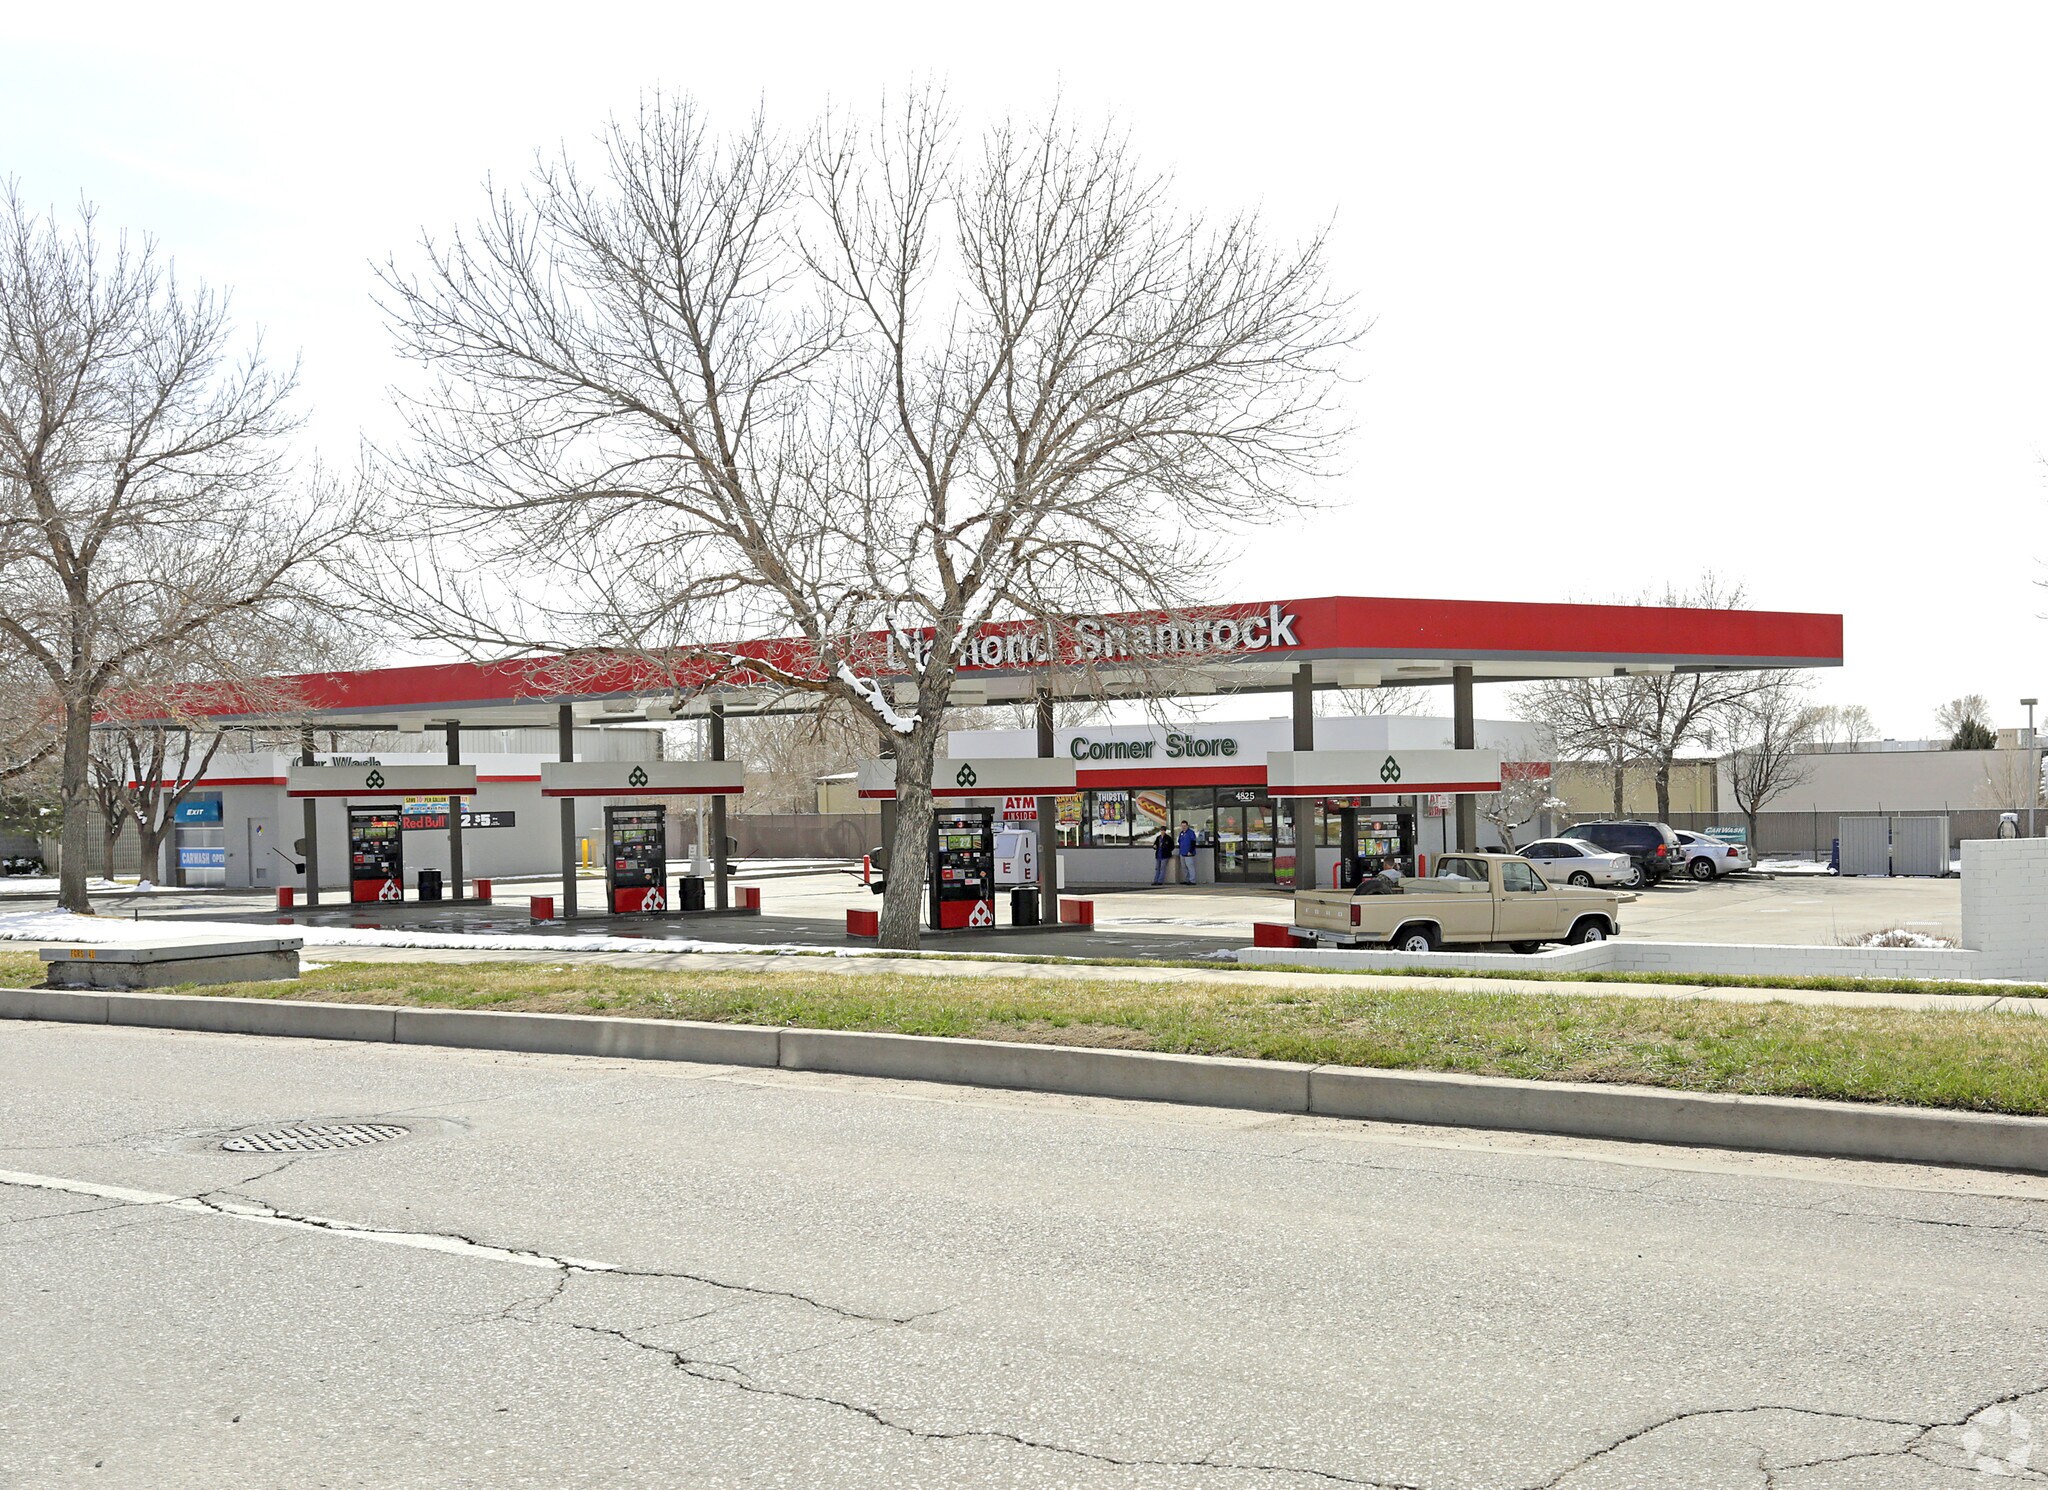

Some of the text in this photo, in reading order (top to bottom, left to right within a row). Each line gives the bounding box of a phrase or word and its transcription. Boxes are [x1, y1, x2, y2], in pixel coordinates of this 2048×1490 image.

[1074, 605, 1299, 660] Shamrock
[1070, 734, 1238, 760] Corner Store
[1098, 793, 1126, 802] THIRSTY
[1236, 792, 1255, 800] 4825
[1005, 797, 1035, 809] ATM
[403, 816, 424, 829] Red
[425, 815, 445, 828] Bull
[461, 814, 471, 827] 2
[475, 814, 491, 826] $5
[1007, 812, 1032, 820] INSIDE
